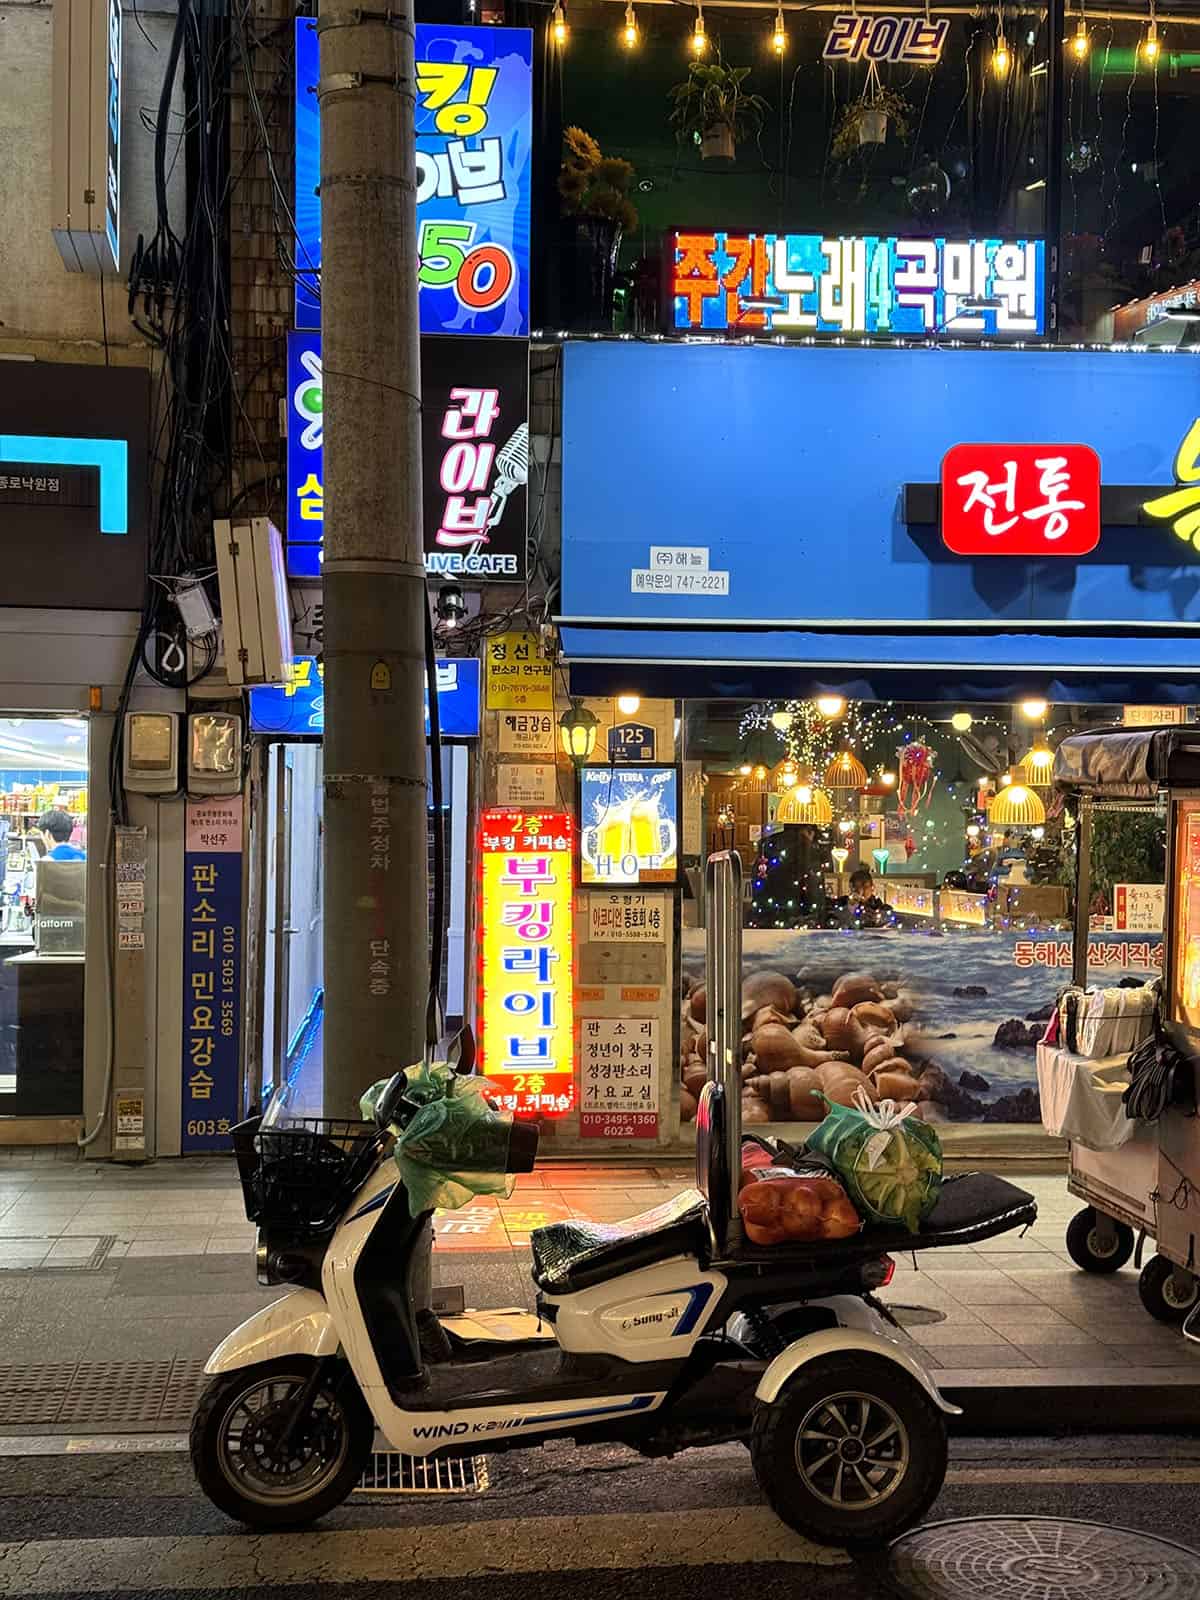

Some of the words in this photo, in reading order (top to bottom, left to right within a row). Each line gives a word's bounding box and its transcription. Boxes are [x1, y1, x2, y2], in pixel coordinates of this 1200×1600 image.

[823, 15, 949, 64] 라이브
[416, 62, 499, 137] 킹
[436, 387, 500, 547] 라이브
[957, 456, 1085, 540] 전통
[423, 552, 464, 573] IVE
[465, 554, 517, 573] CAFE
[676, 575, 725, 589] 747-2221
[505, 716, 551, 732] 해금강습
[618, 728, 645, 744] 125
[511, 816, 543, 834] 2층
[486, 835, 516, 851] 부킹
[192, 863, 218, 959] 판소리
[223, 926, 235, 953] 010
[500, 857, 557, 1070] 부킹라이브
[222, 959, 234, 993] 5031
[222, 1000, 233, 1036] 3569
[189, 971, 217, 1099] 민요강습
[586, 1042, 624, 1058] 정년이
[628, 1042, 654, 1058] 창극
[512, 1074, 546, 1093] 2층
[187, 1117, 231, 1136] 603호
[583, 1114, 656, 1125] 010-3495-1360
[604, 1126, 635, 1136] 602호
[413, 1422, 469, 1439] WIND
